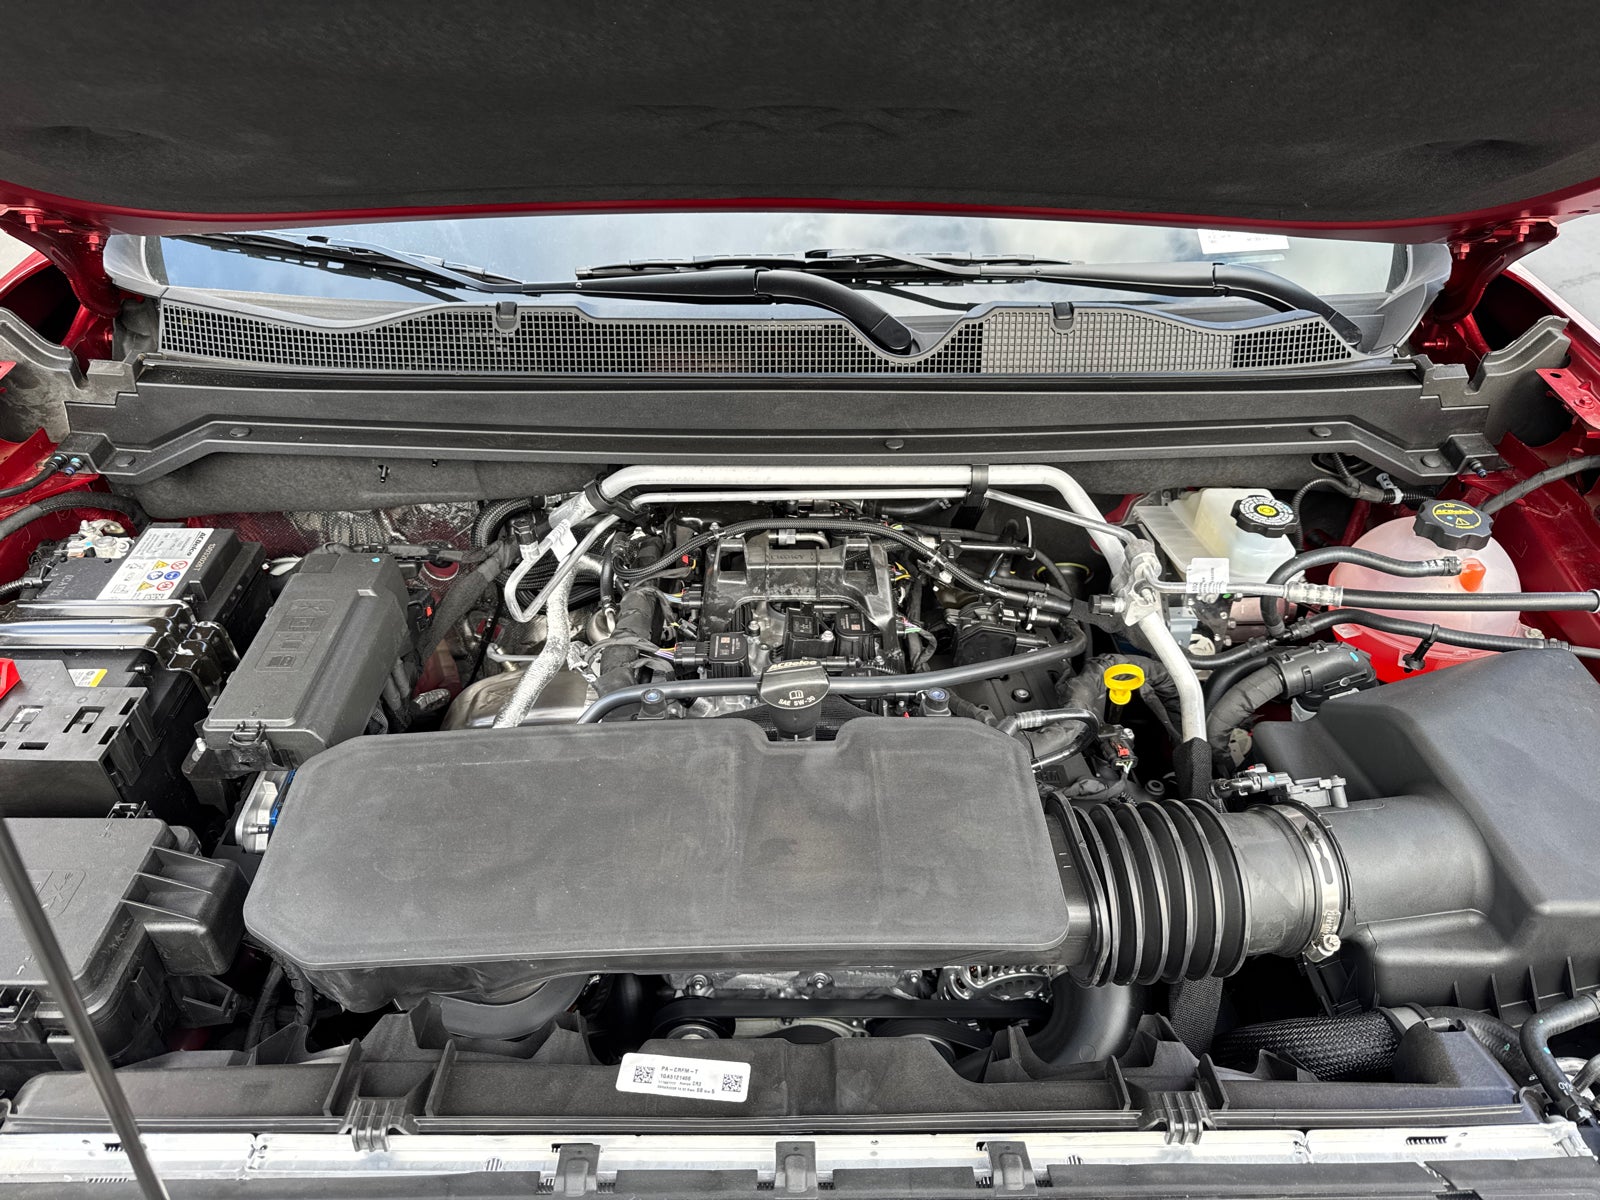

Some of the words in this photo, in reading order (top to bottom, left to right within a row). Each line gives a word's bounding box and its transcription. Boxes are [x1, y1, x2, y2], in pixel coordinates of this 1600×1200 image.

[186, 531, 206, 556] ACDelco
[766, 660, 818, 673] ACDelco
[777, 698, 792, 707] SAE
[793, 695, 816, 707] 5W-30
